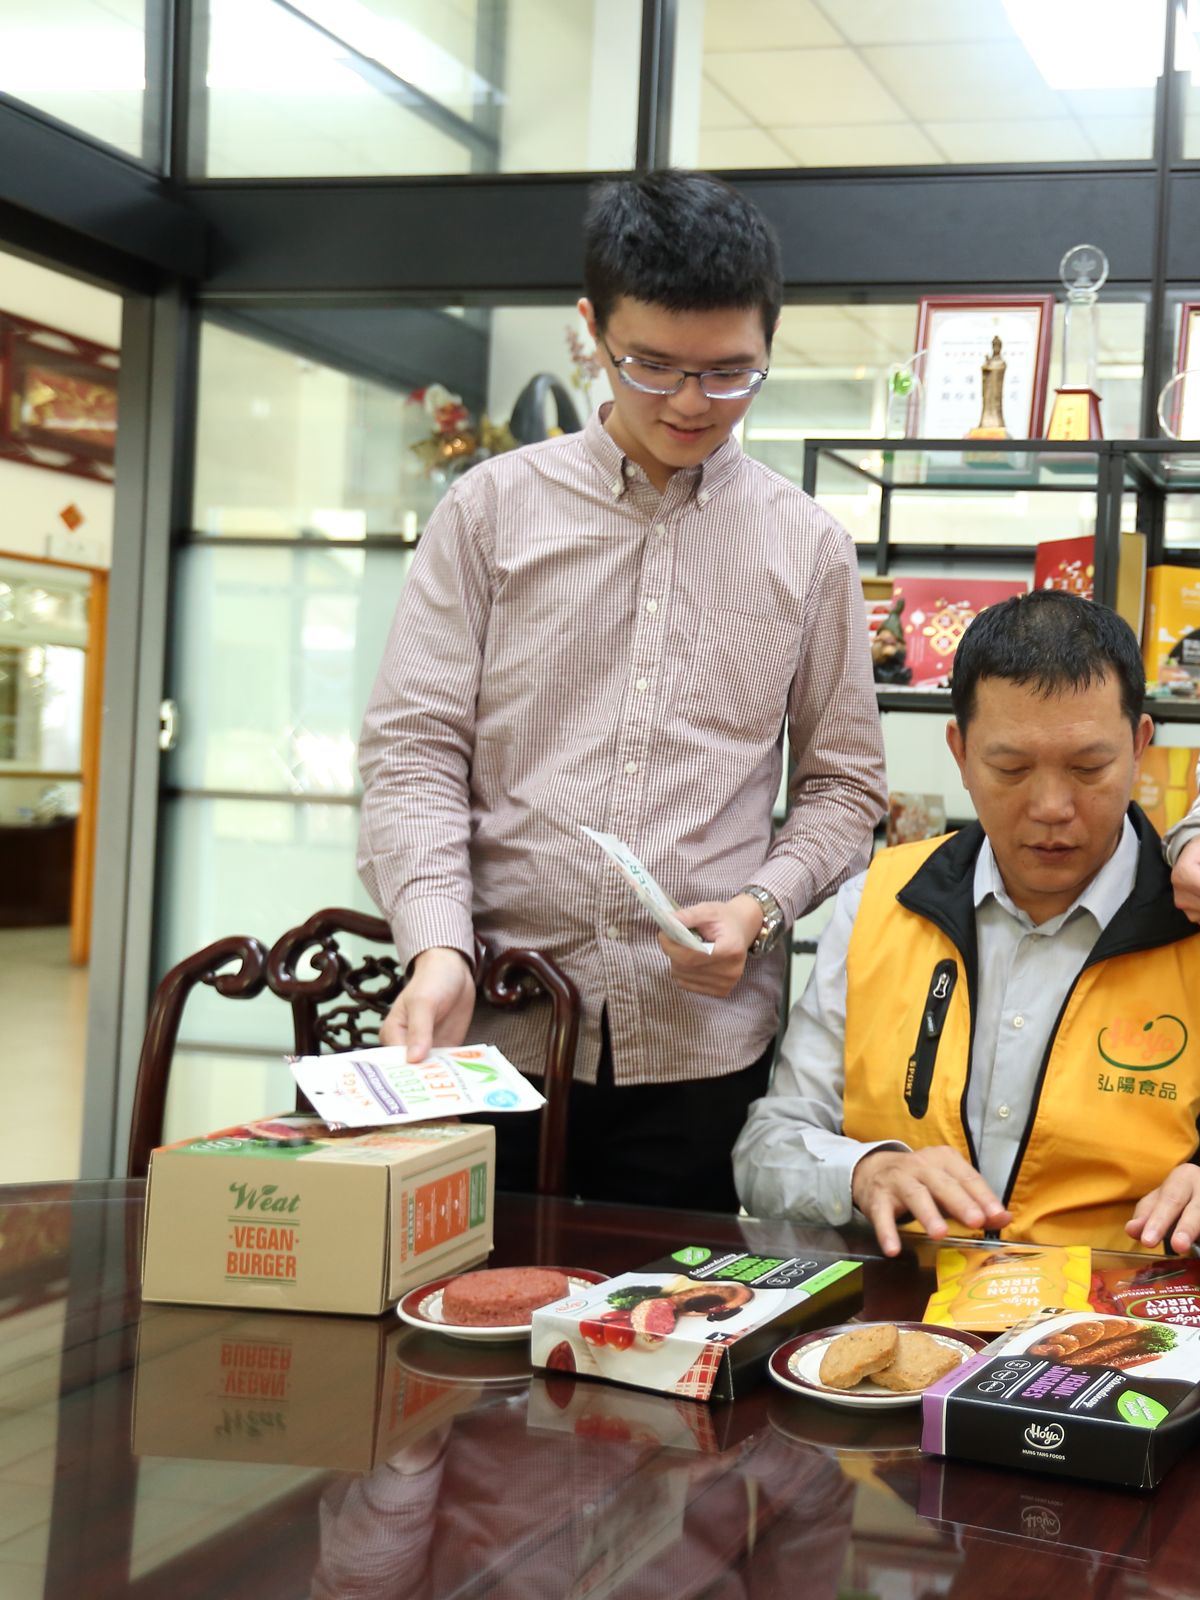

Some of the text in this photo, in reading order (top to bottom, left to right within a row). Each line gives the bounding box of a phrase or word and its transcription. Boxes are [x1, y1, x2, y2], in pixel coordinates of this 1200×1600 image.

[905, 1060, 917, 1097] SPORT
[1097, 1073, 1178, 1101] 弘陽食品
[228, 1182, 301, 1213] Weat
[233, 1225, 295, 1252] VEGAN
[226, 1251, 297, 1278] BURGER
[986, 1285, 1041, 1296] VEGAN
[988, 1277, 1041, 1288] JERKY
[1145, 1297, 1196, 1309] JERKY
[1021, 1365, 1074, 1399] SAUSAGES
[1051, 1373, 1092, 1397] VEGAN
[1083, 1374, 1127, 1409] Extraordinary
[1030, 1422, 1061, 1445] Hoya
